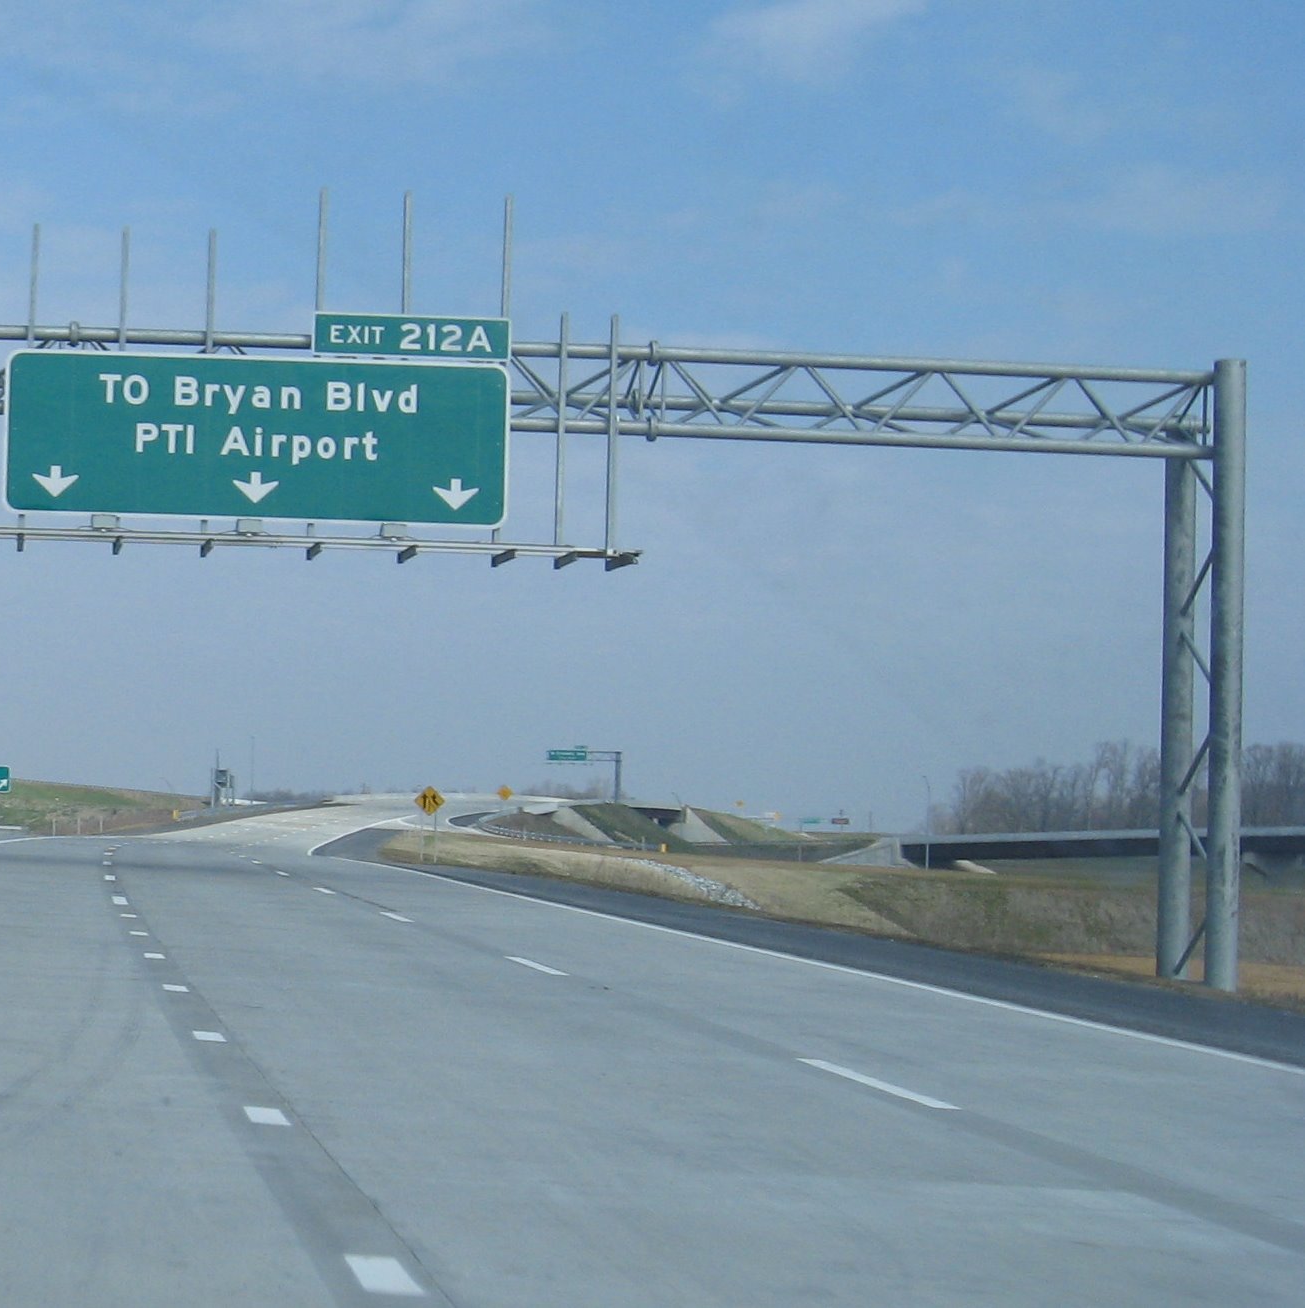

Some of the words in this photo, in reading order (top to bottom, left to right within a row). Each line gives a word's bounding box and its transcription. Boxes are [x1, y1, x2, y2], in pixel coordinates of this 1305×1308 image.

[329, 324, 385, 346] EXIT
[399, 322, 492, 353] 212A
[99, 373, 150, 404] TO
[174, 375, 301, 415] Bryan
[326, 381, 418, 414] Blvd
[135, 422, 195, 454] PTI
[220, 426, 379, 466] Airport
